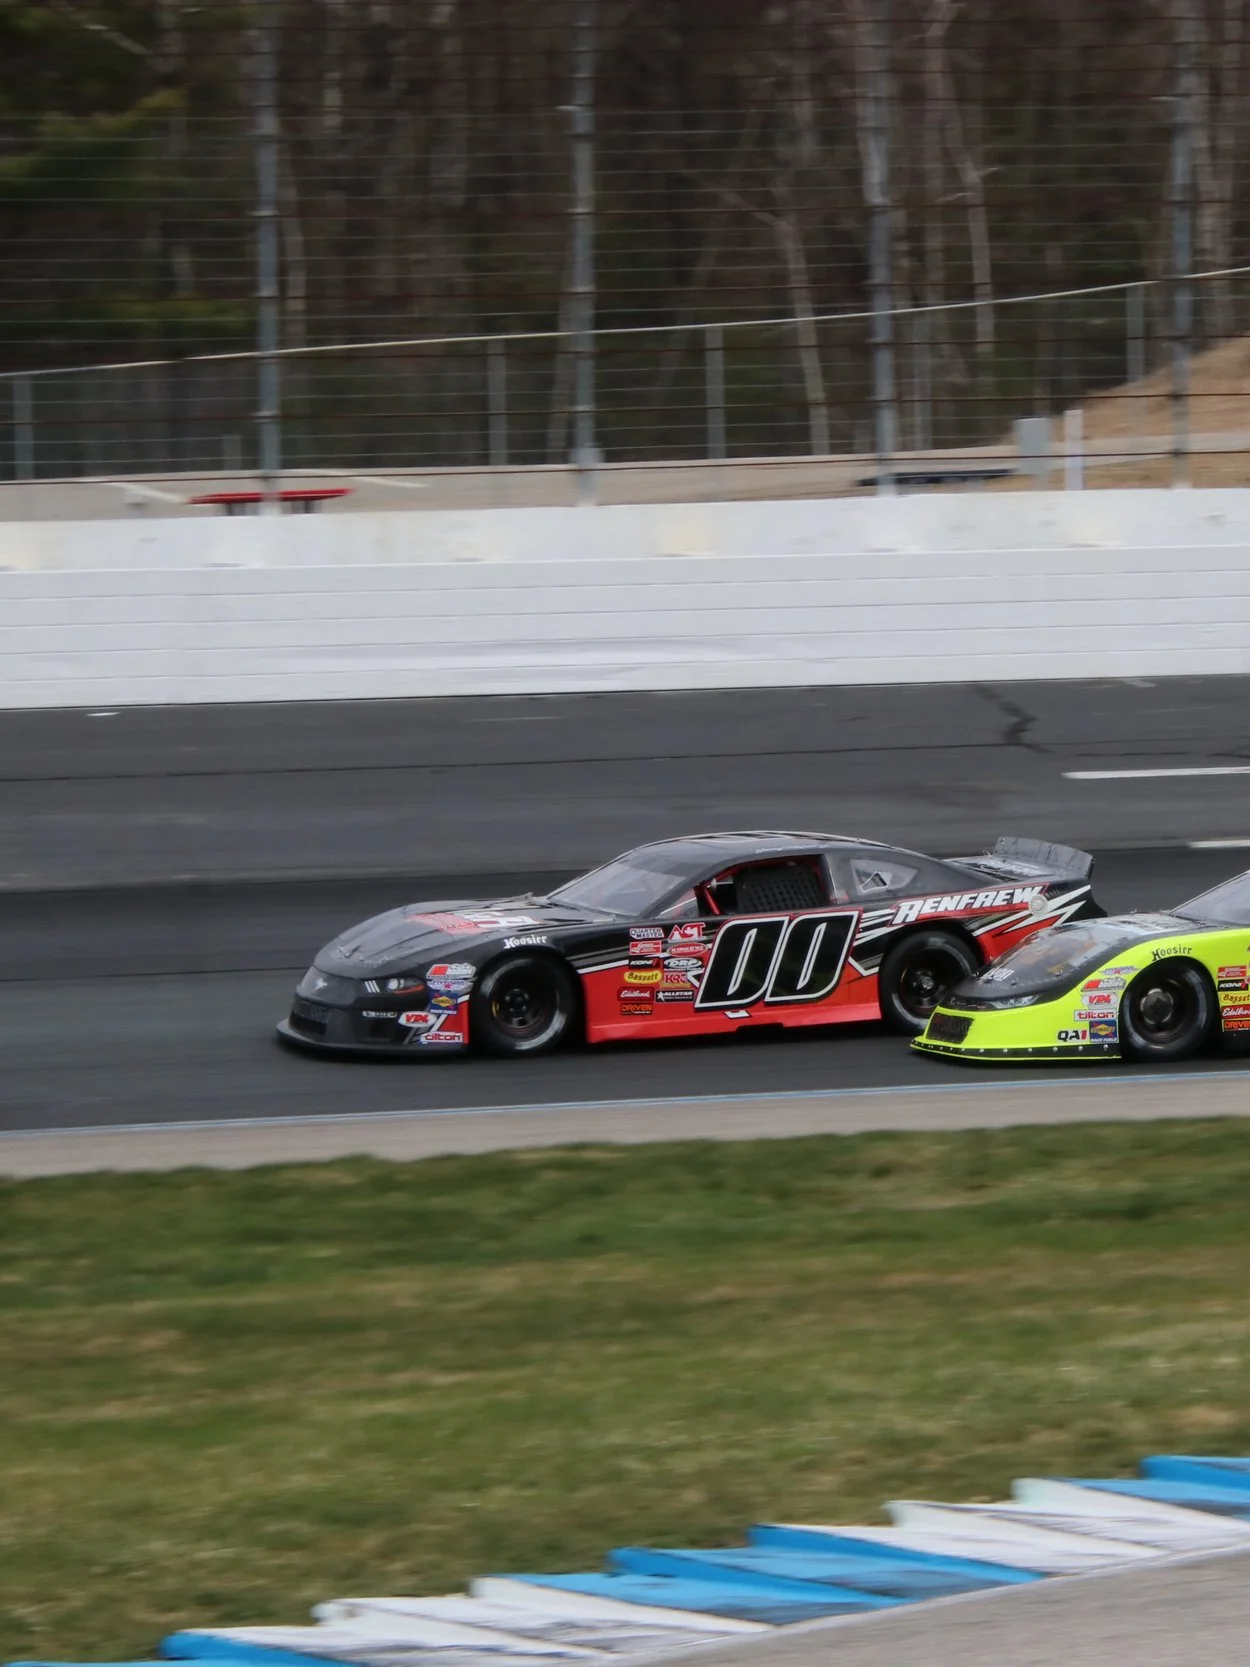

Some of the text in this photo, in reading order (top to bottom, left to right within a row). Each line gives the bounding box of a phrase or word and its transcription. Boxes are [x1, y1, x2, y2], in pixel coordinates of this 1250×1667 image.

[892, 885, 1044, 925] RENFREW
[667, 922, 706, 942] ACT
[503, 935, 549, 950] Hoosier
[693, 910, 860, 1010] 00
[1152, 943, 1193, 962] Hoosier
[627, 971, 659, 982] Bassett
[621, 1004, 652, 1012] DRIVEN
[1077, 1010, 1115, 1019] tilton
[1057, 1029, 1087, 1042] QA1
